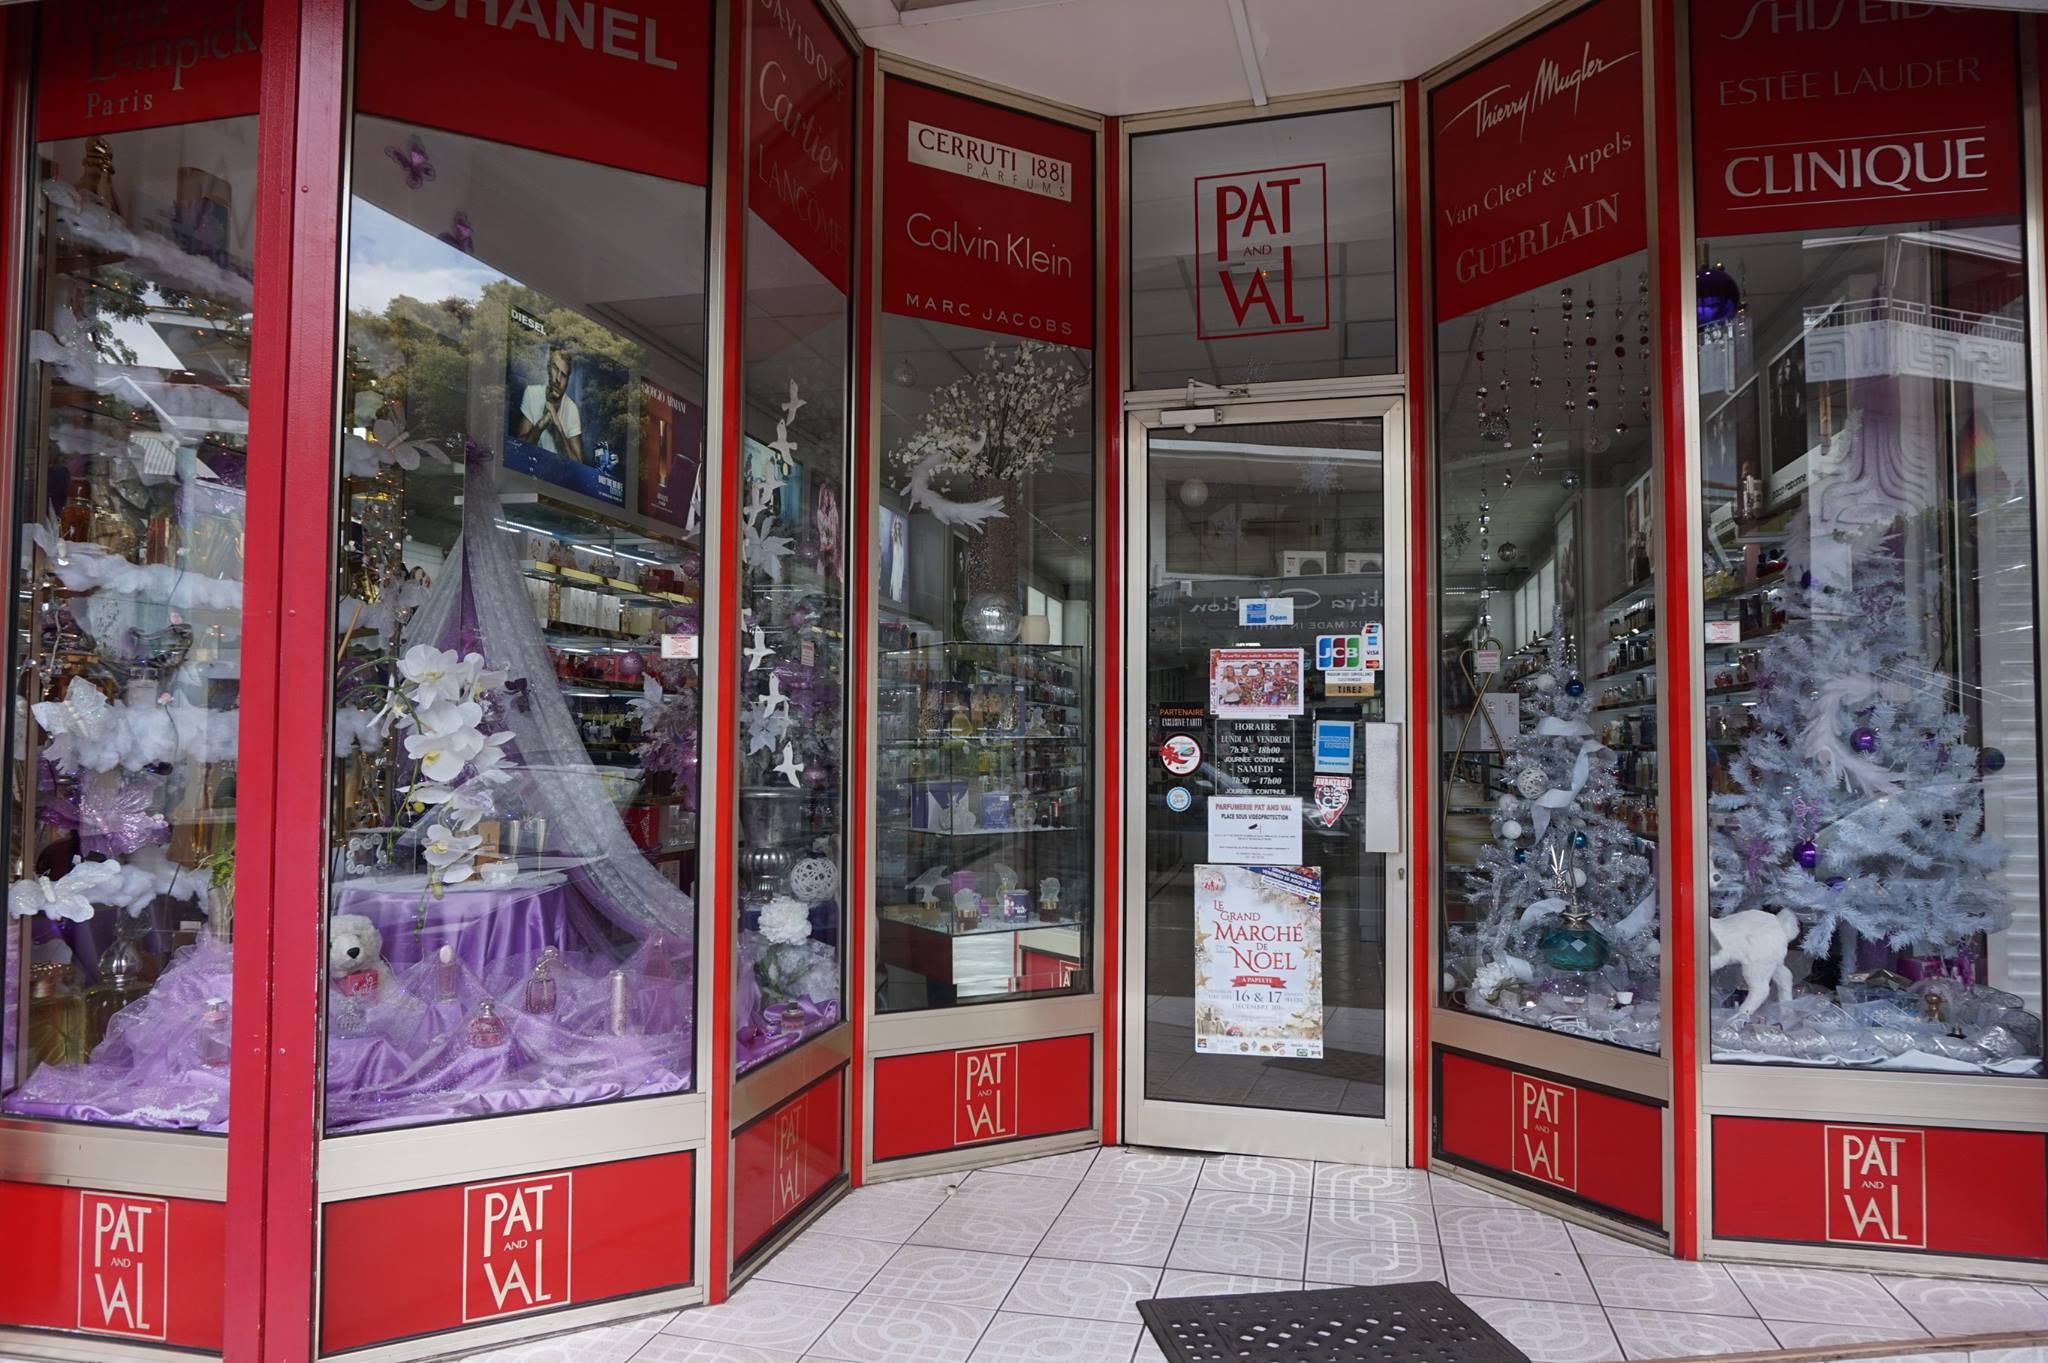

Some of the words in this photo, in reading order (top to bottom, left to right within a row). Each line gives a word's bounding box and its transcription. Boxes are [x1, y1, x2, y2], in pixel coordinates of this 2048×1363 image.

[406, 0, 678, 71] HANEL
[761, 0, 845, 103] AVIDOFF
[1440, 84, 1531, 144] Thierry
[1531, 41, 1641, 116] Mugler
[1833, 57, 1983, 96] LAUDER
[85, 88, 154, 118] Paris
[759, 61, 845, 181] Cartier
[918, 128, 1016, 171] CERRUTI
[1031, 157, 1065, 183] 1881
[1724, 136, 1989, 198] CLINIQUE
[966, 162, 1066, 197] PARFUMS
[1445, 202, 1478, 227] Van
[1483, 168, 1537, 211] Cleef
[1541, 167, 1557, 186] &
[1563, 131, 1633, 174] Arpels
[1216, 179, 1301, 261] PAT
[906, 212, 999, 263] Calvin
[1007, 232, 1072, 279] Klein
[1243, 245, 1272, 257] AND
[1455, 192, 1620, 284] GUERLAIN
[1218, 246, 1305, 327] VAL
[511, 308, 547, 336] DIESEL
[905, 292, 971, 317] MARC
[982, 308, 1073, 336] JACOBS
[1269, 614, 1288, 622] Open
[1337, 685, 1362, 694] TIREZ
[1159, 708, 1204, 716] PARTENAIRE
[1234, 722, 1277, 731] HORAIRE
[1220, 735, 1242, 743] LUNDI
[1245, 735, 1255, 743] AU
[1256, 735, 1291, 744] VENDREDI
[1229, 746, 1249, 754] 7h30
[1258, 746, 1281, 754] 18h00
[1231, 776, 1250, 784] 7h30
[1259, 776, 1282, 785] 17h00
[1236, 765, 1274, 773] SAMEDI
[1315, 778, 1350, 787] AVANTAGE
[1215, 803, 1253, 811] PARFUMERIE
[1254, 803, 1265, 811] PAT
[1213, 899, 1225, 912] LE
[1220, 910, 1261, 922] GRAND
[1212, 922, 1304, 945] MARCHÉ
[1256, 942, 1269, 951] DE
[1234, 989, 1250, 1002] 16
[1253, 991, 1264, 1003] &
[1268, 990, 1283, 1003] 17
[966, 1052, 1007, 1101] PAT
[977, 1089, 992, 1097] AND
[966, 1089, 1007, 1138] VAL
[1523, 1081, 1564, 1130] PAT
[1535, 1125, 1550, 1134] AND
[1523, 1131, 1565, 1183] VAL
[1843, 1134, 1906, 1190] PAT
[1861, 1180, 1884, 1190] AND
[484, 1184, 552, 1258] PAT
[1843, 1184, 1907, 1241] VAL
[95, 1202, 152, 1268] PAT
[503, 1239, 528, 1251] AND
[110, 1257, 131, 1268] AND
[484, 1239, 552, 1311] VAL
[95, 1262, 151, 1330] VAL
